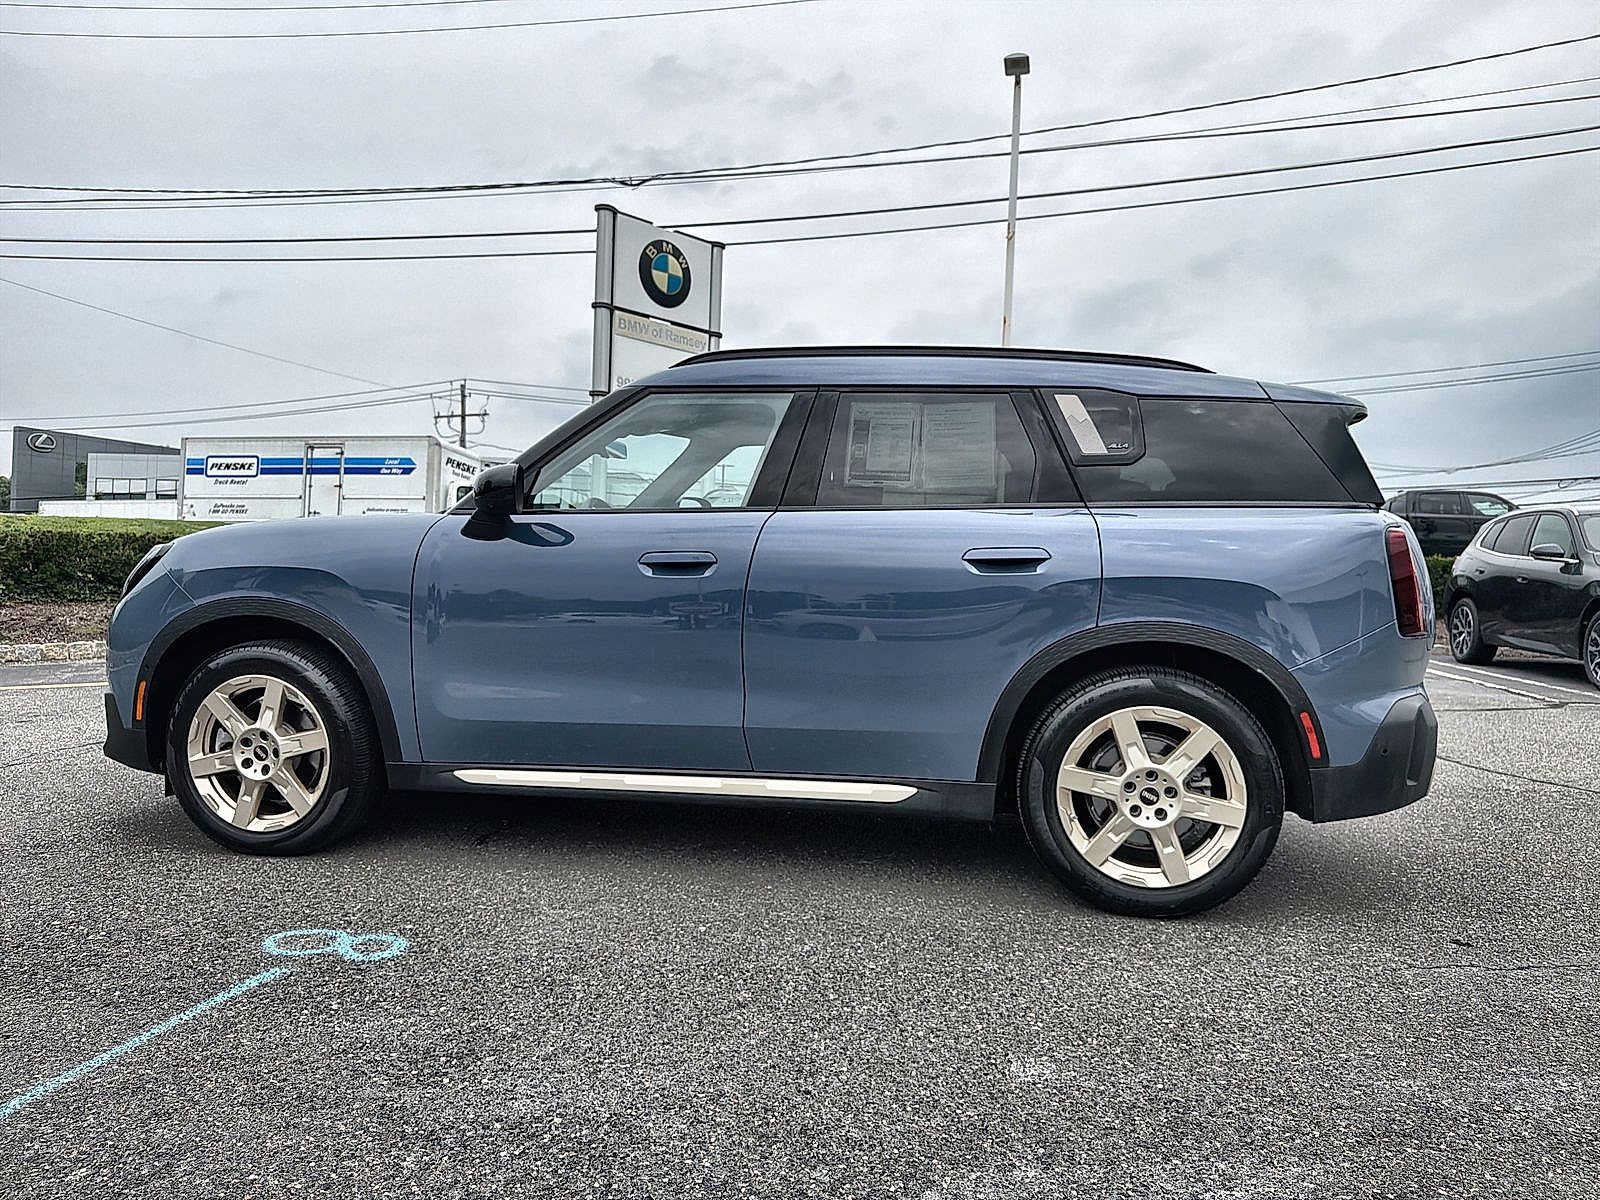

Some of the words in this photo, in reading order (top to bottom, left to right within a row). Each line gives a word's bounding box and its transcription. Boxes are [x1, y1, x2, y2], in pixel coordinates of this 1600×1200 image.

[646, 241, 688, 268] BMW
[618, 318, 650, 335] BMW
[651, 326, 663, 338] of
[665, 329, 707, 350] Ramsey
[209, 462, 255, 471] PENSKE
[445, 457, 478, 476] PENSKE
